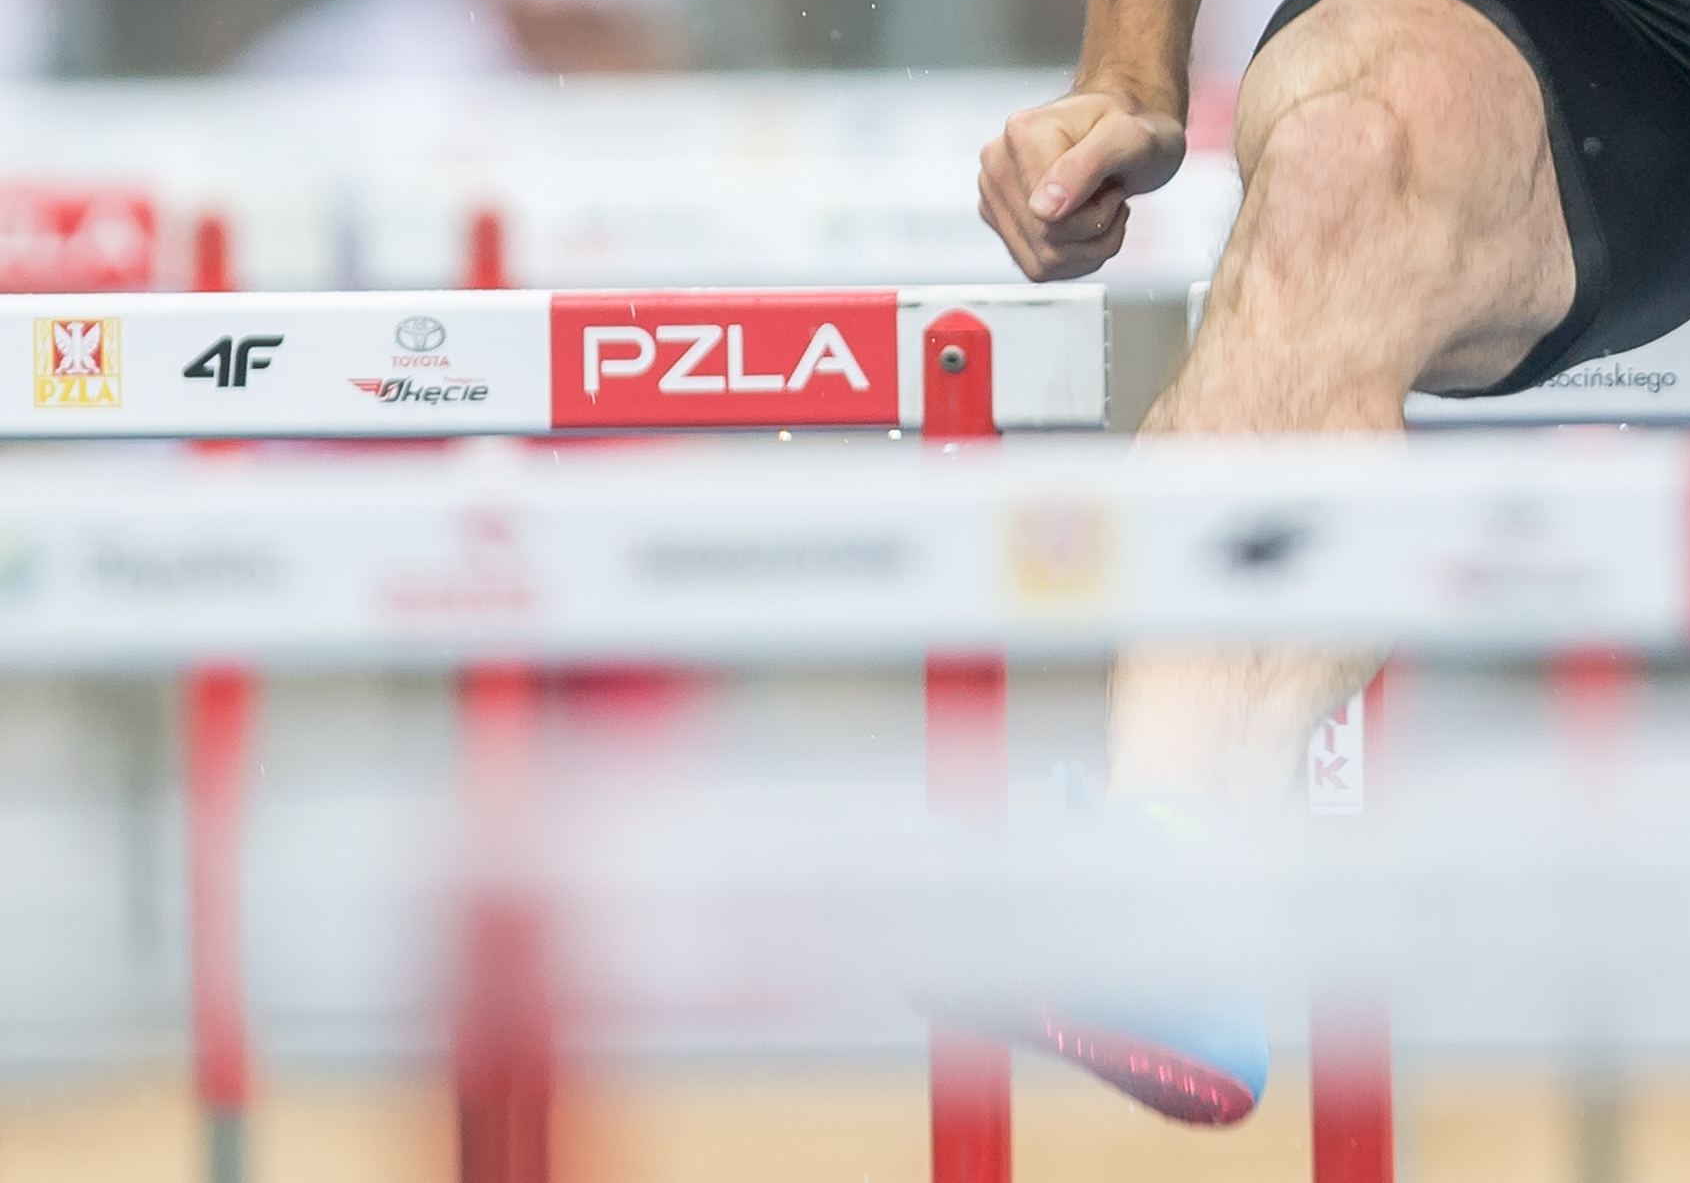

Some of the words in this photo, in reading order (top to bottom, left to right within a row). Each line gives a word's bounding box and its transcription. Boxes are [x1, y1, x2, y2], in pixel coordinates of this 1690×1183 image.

[182, 333, 285, 388] 4F
[390, 355, 452, 368] TOYOTA
[582, 322, 871, 394] PZLA
[37, 378, 116, 405] PZLA
[1537, 362, 1676, 394] socińskiego
